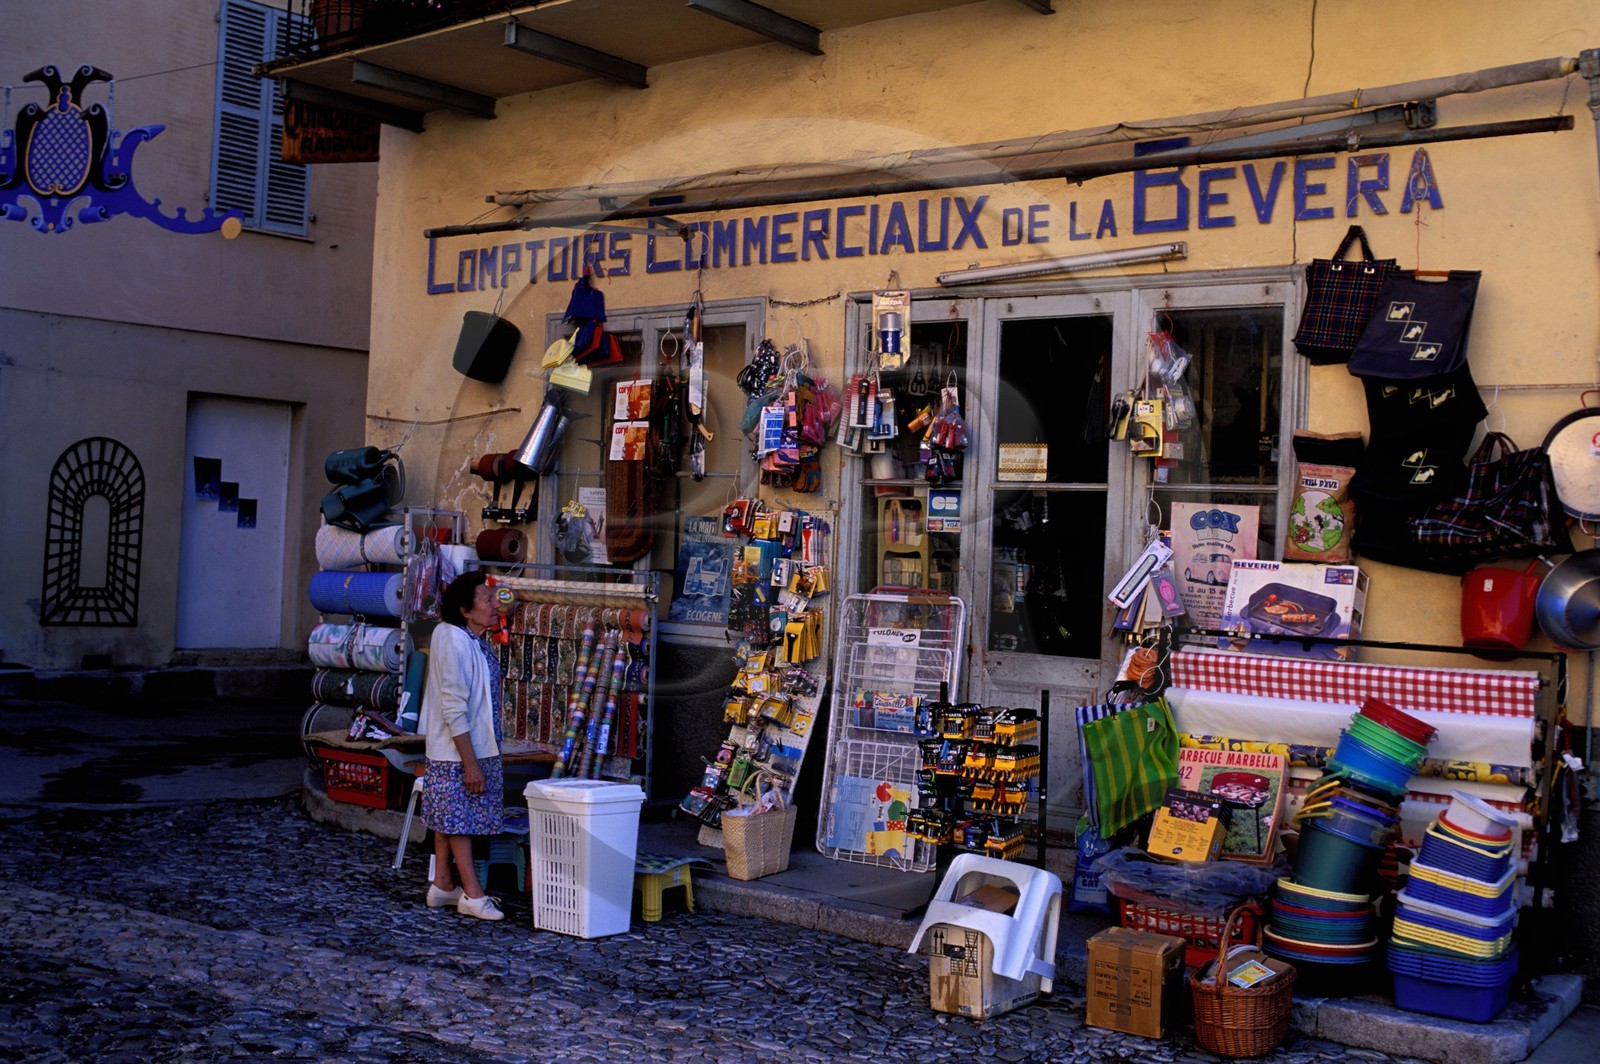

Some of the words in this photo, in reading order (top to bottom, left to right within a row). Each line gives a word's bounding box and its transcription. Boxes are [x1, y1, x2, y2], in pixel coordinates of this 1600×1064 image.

[646, 195, 990, 274] COMMERCIAUX
[1002, 204, 1050, 246] DE
[1069, 199, 1118, 241] LA
[1132, 136, 1444, 235] BEVERA
[931, 496, 958, 510] CB
[1190, 508, 1241, 535] COX
[1234, 561, 1280, 570] SEVERIN
[1225, 586, 1237, 621] Barbecue
[1180, 749, 1222, 765] ARBECUE
[1226, 752, 1278, 769] MARBELLA
[1081, 878, 1099, 888] CAT
